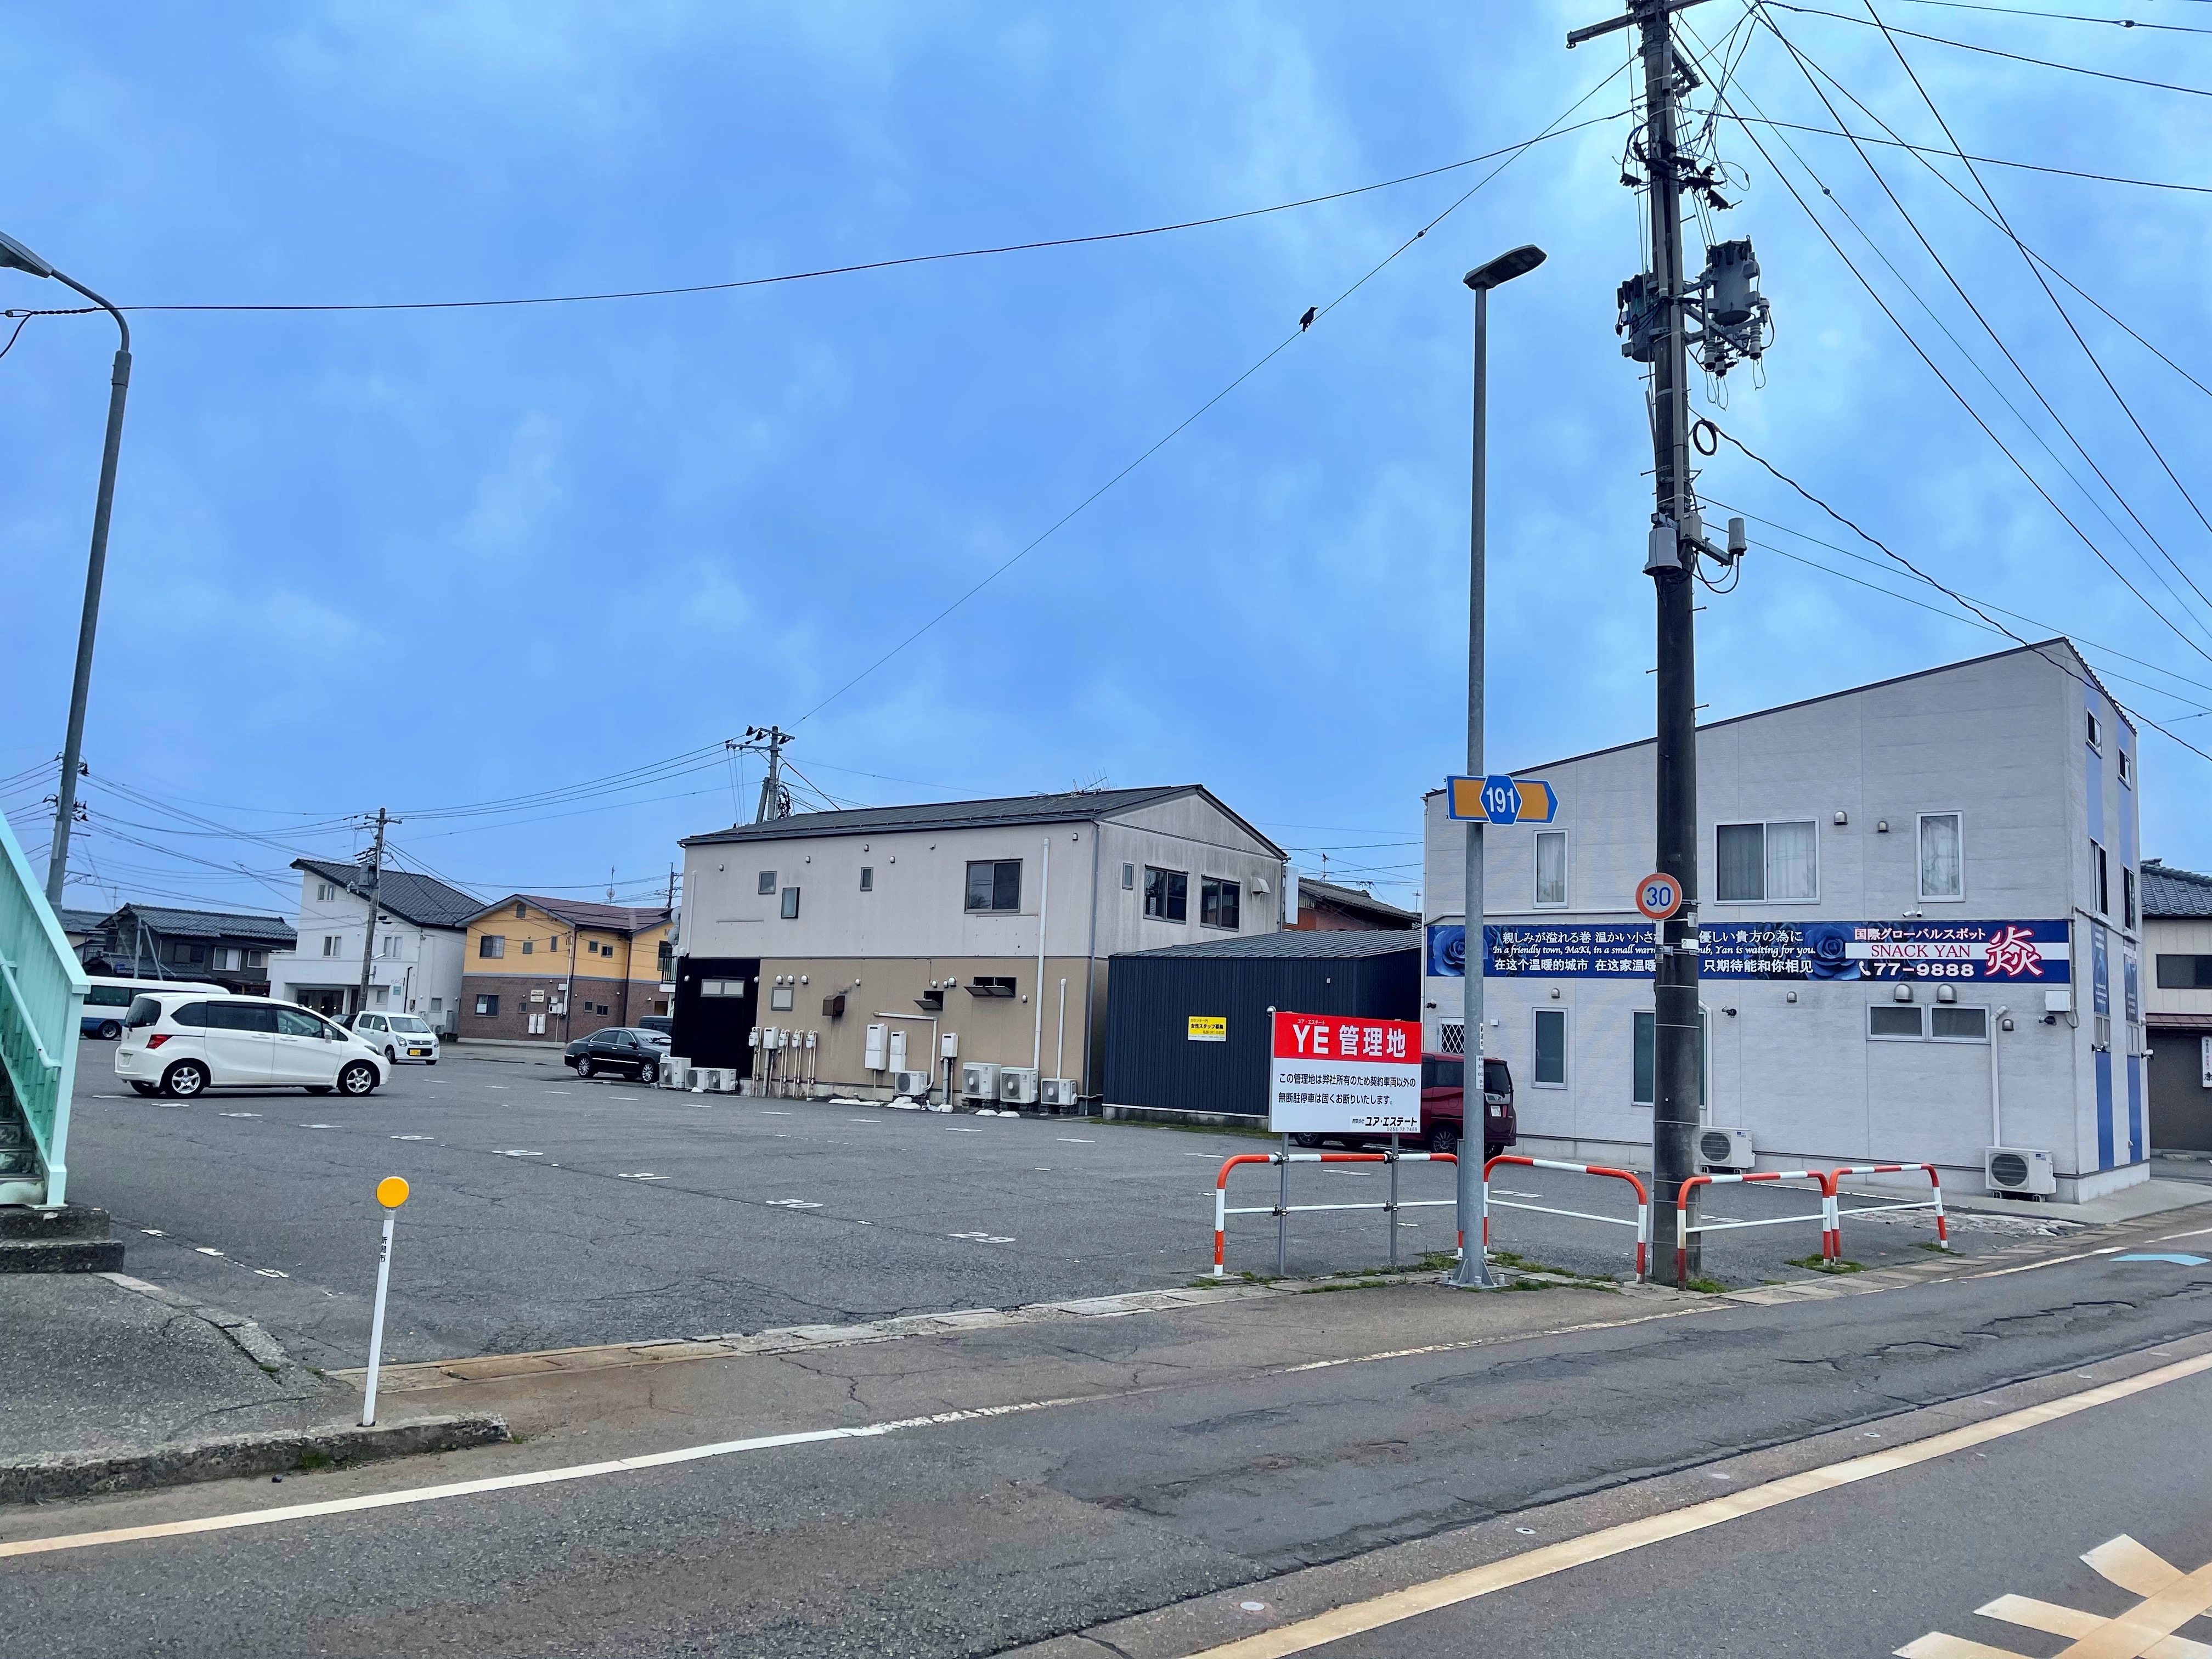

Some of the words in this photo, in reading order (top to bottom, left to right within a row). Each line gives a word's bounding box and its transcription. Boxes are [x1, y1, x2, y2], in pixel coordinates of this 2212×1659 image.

[1486, 787, 1515, 813] 191
[1646, 887, 1671, 906] 30
[1503, 932, 1592, 944] 親しみが溢れる巻
[1699, 930, 1803, 944] 優しい貴方の為に
[1854, 928, 1985, 941] 国際グローバルスポット
[1510, 944, 1541, 957] friendly
[1542, 947, 1563, 956] town,
[1594, 946, 1602, 954] in
[1611, 944, 1634, 954] small
[1715, 945, 1734, 954] Yan
[1736, 945, 1743, 954] is
[1745, 945, 1779, 957] waiting
[1780, 944, 1796, 958] for
[1796, 947, 1816, 958] you.
[1871, 945, 1928, 957] SNACK
[1934, 945, 1971, 958] YAN
[1494, 959, 1588, 971] 在这个温暖的城市
[1594, 959, 1656, 972] 在这家温暖
[1703, 960, 1814, 973] 只期待能和你相见
[1874, 962, 1974, 977] 77-9888
[1293, 1024, 1329, 1054] YE
[1339, 1025, 1406, 1058] 管理地
[1279, 1073, 1416, 1087] この管理地は弊社所有のため契約車両以外の
[1278, 1092, 1393, 1105] 無断駐停車は固くお断りいたします。
[1365, 1116, 1418, 1126] ユア・エステート
